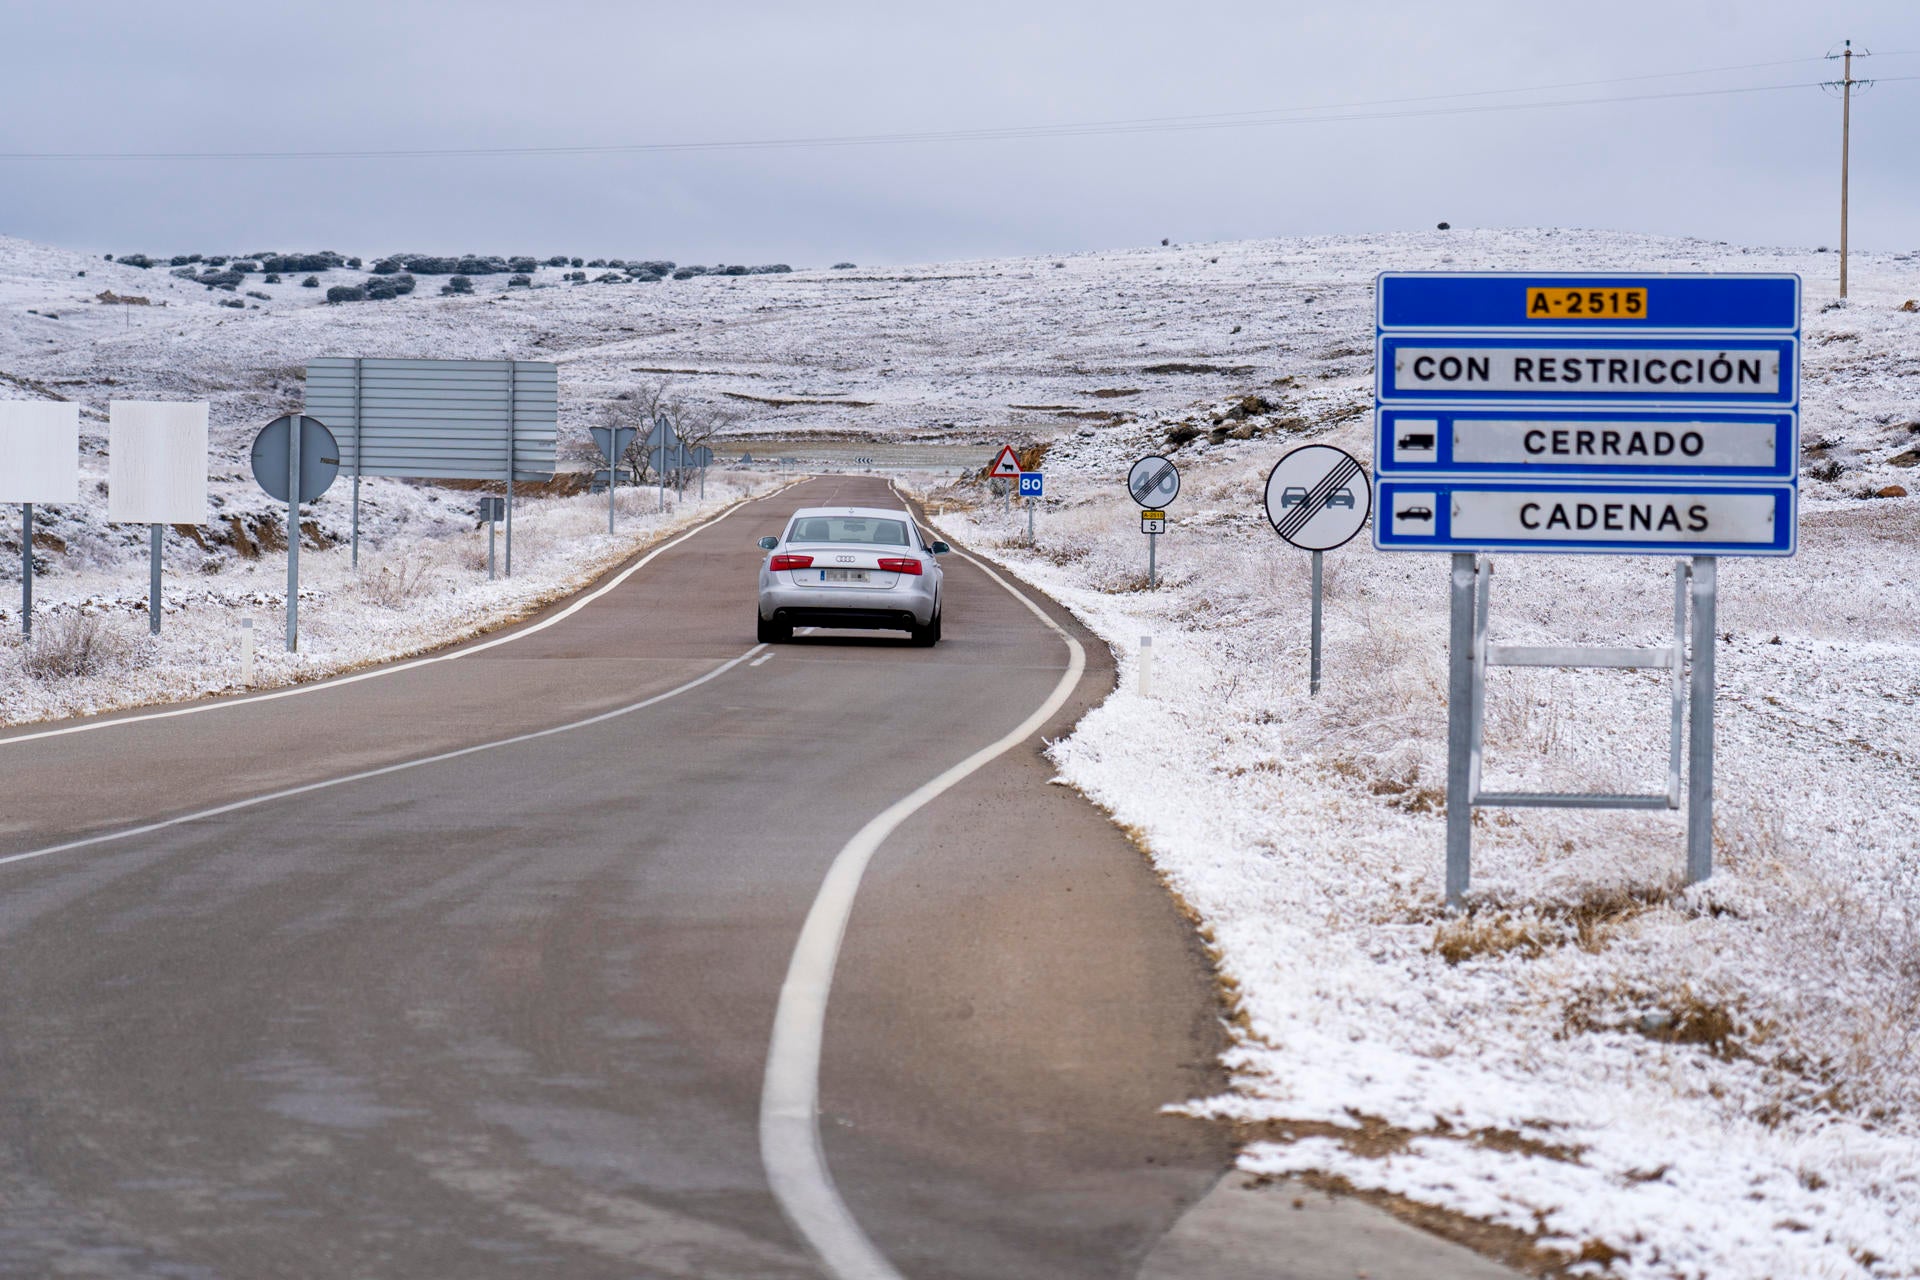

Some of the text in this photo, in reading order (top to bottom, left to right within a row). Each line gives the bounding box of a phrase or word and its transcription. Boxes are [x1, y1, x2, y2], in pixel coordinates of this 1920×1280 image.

[1531, 292, 1642, 315] A-2515
[1413, 353, 1761, 385] CON RESTRICCIÓN
[1523, 430, 1705, 457] CERRADO
[1021, 478, 1042, 490] 80
[1132, 471, 1177, 494] 40
[1150, 521, 1157, 531] 5
[1519, 502, 1710, 532] CADENAS
